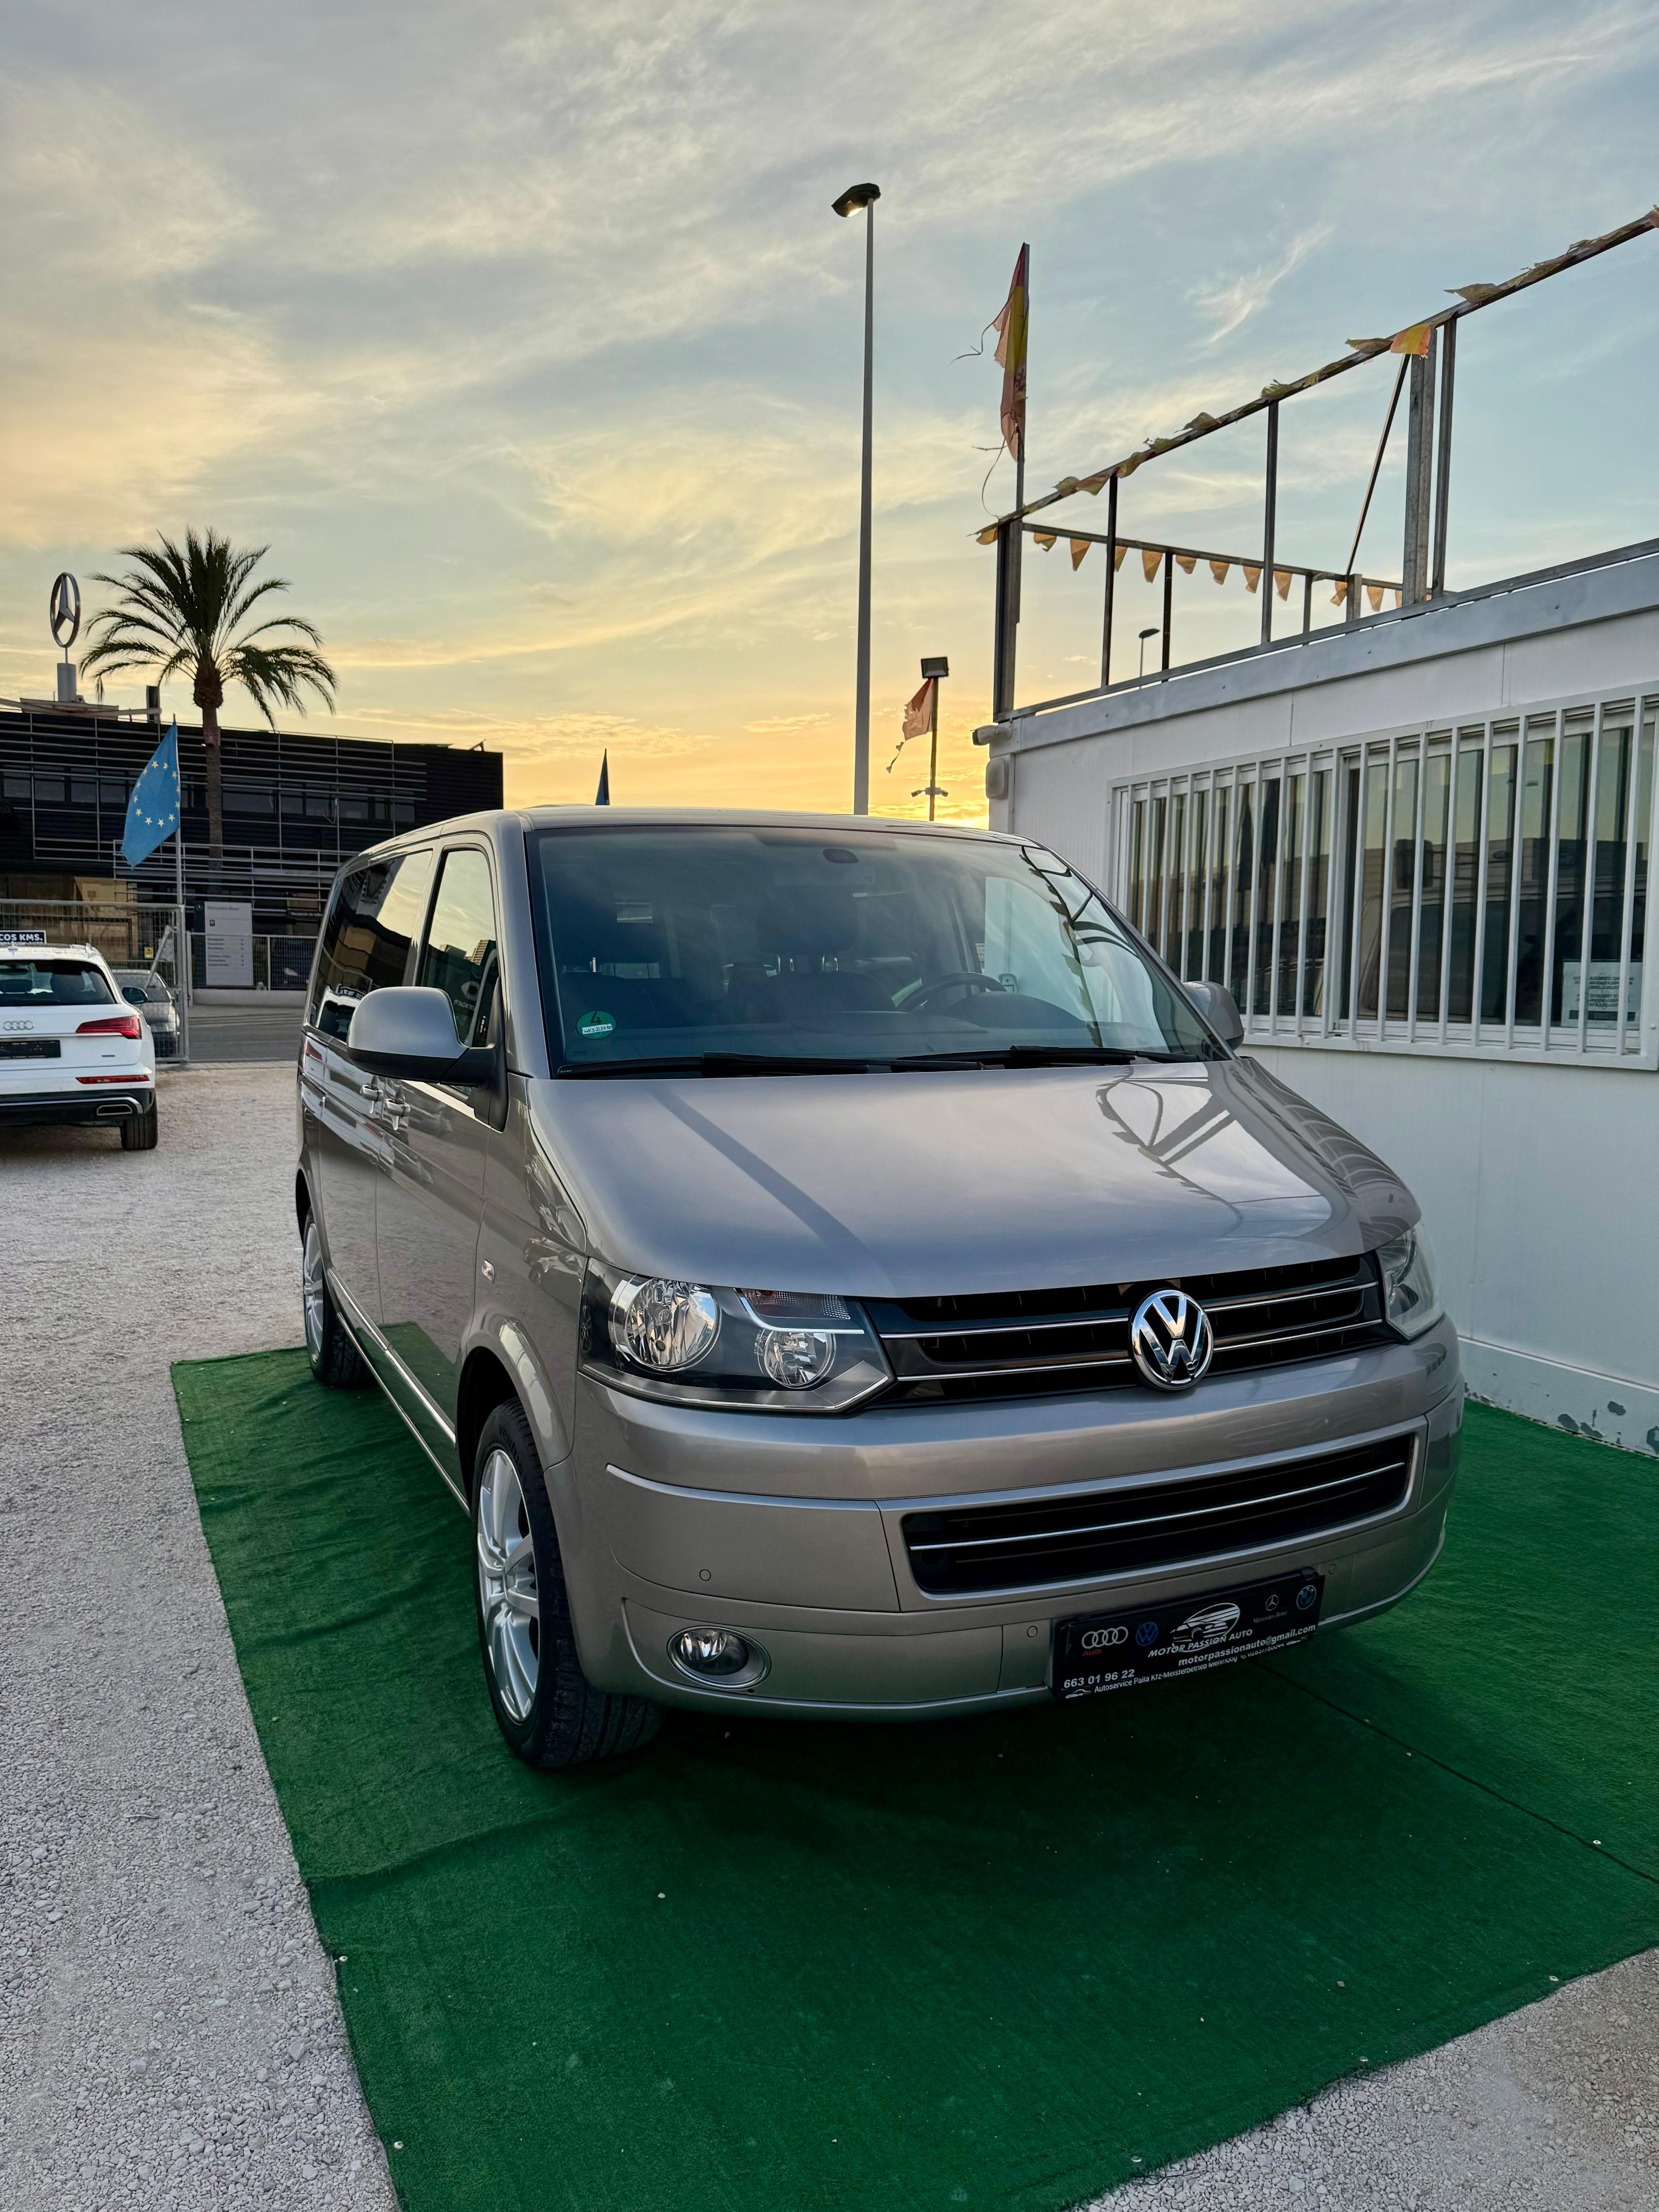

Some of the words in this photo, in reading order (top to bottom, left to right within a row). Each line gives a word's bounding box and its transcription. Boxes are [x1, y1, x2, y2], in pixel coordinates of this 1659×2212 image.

[590, 1011, 601, 1024] 4
[1147, 1644, 1185, 1658] MOTOR
[1187, 1635, 1227, 1650] PASSION
[1229, 1629, 1253, 1641] AUTO
[1178, 1624, 1316, 1666] motorpassionauto@gmail.com
[1064, 1677, 1084, 1688] 663
[1087, 1675, 1101, 1684] 01
[1105, 1672, 1118, 1681] 96
[1121, 1669, 1135, 1679] 22
[1094, 1679, 1133, 1693] Autoservice
